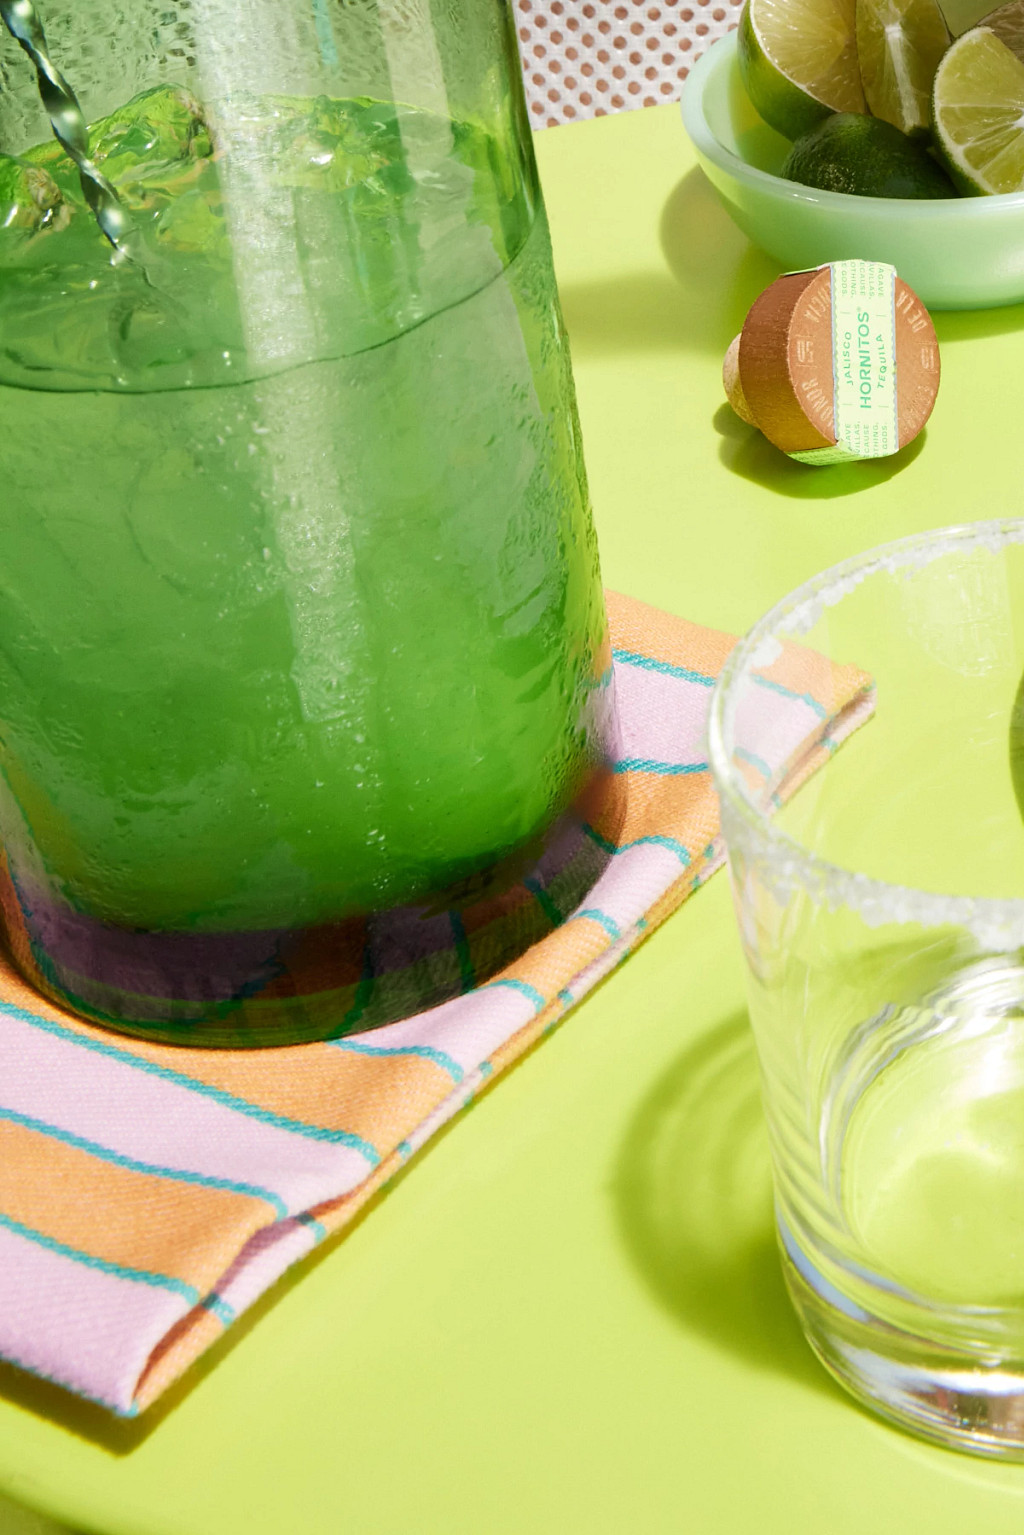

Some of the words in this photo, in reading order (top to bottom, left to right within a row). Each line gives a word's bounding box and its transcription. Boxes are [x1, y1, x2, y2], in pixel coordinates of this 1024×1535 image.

[877, 268, 885, 297] AGAVE
[842, 331, 854, 386] JALISCO
[857, 311, 872, 409] HORNITOS
[875, 333, 888, 389] TEQUILA
